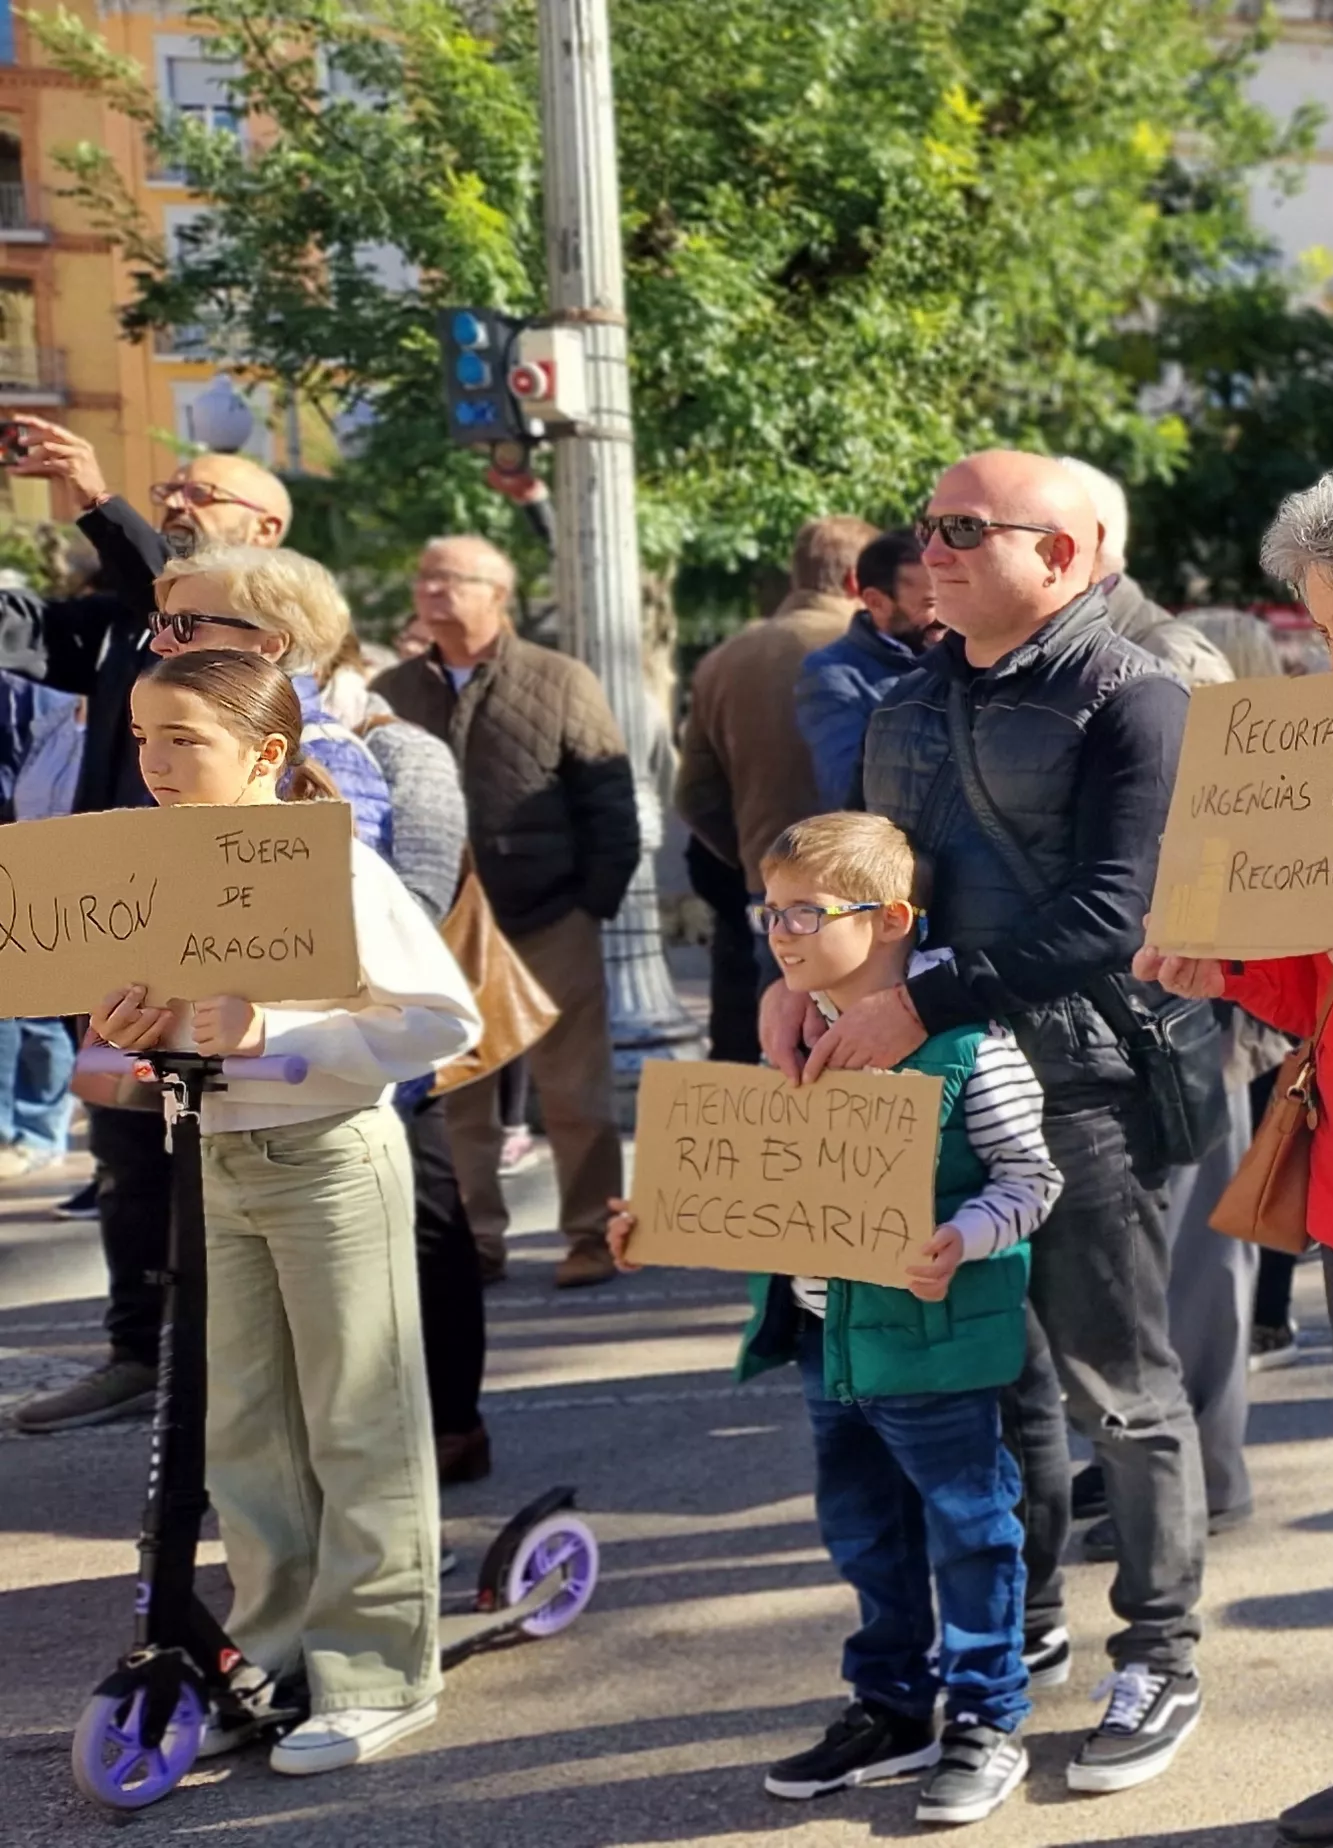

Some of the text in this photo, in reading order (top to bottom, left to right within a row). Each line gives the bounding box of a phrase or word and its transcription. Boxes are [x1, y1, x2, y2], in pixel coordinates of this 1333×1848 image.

[215, 829, 310, 865] FUERA
[216, 885, 255, 909] DE
[179, 926, 315, 966] ARAGÓN
[665, 1078, 810, 1131] ATENCIÓN
[675, 1135, 907, 1188] RIA ES MUY
[653, 1187, 914, 1253] NECESARIA
